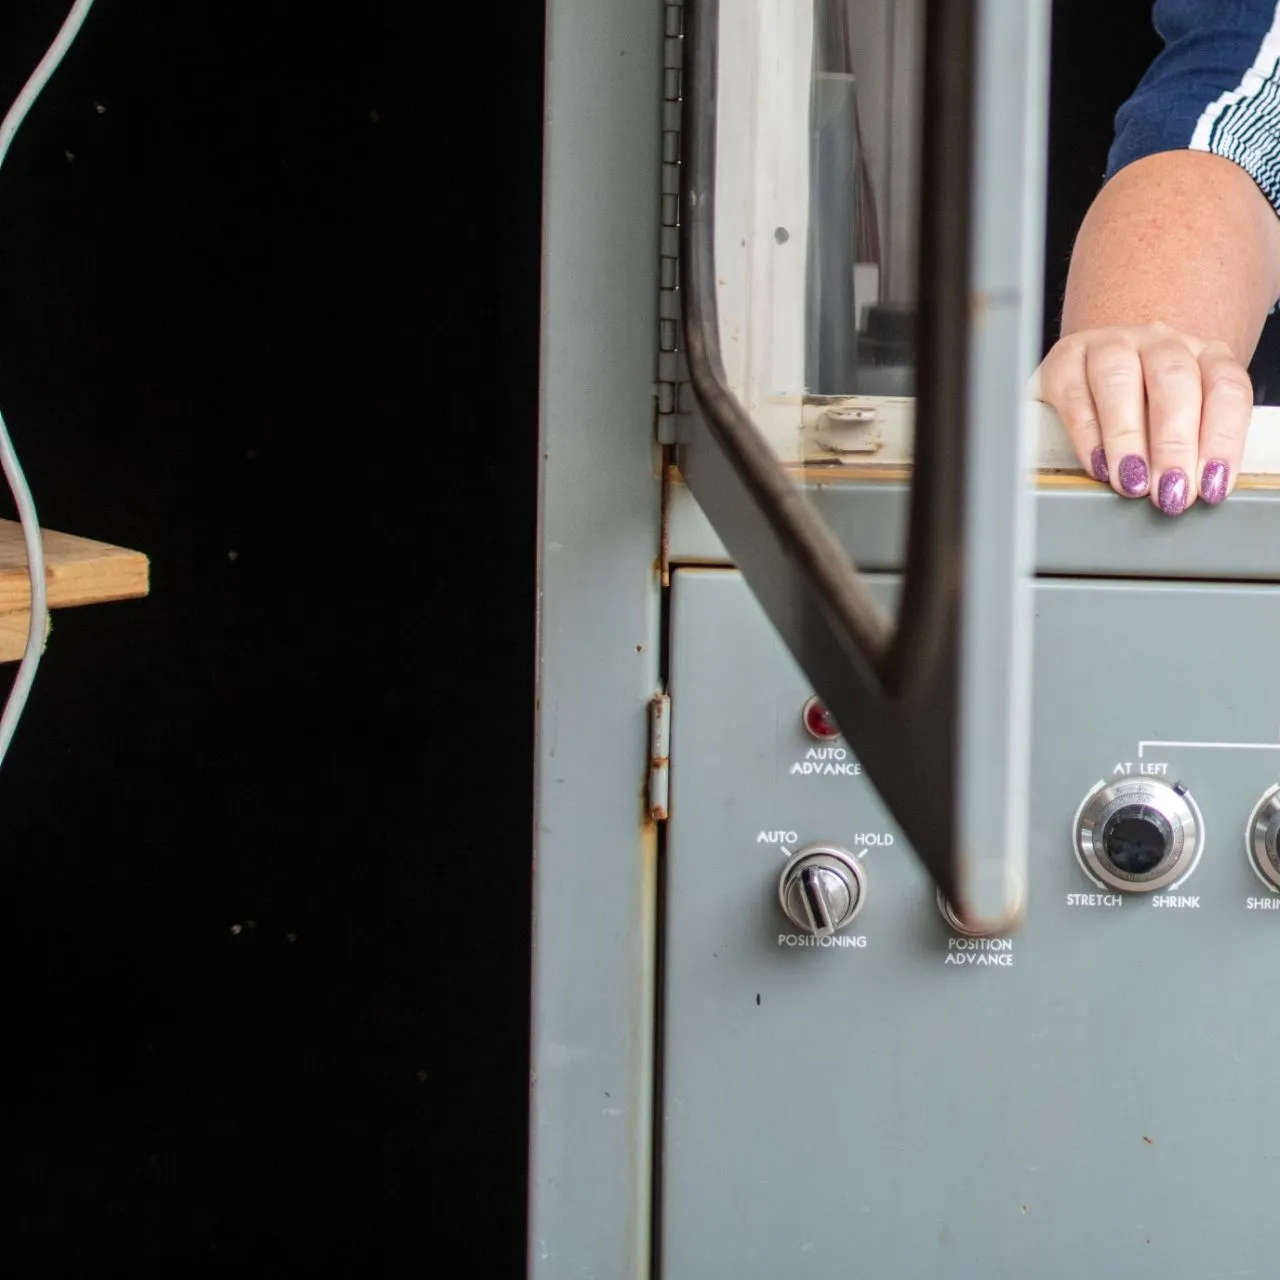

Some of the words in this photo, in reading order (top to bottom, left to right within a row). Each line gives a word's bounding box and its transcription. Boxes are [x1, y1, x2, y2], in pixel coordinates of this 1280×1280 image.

[805, 747, 847, 761] AUTO
[789, 762, 862, 776] ADVANCE
[1113, 762, 1133, 775] AT
[1140, 762, 1169, 775] LEFT
[756, 830, 798, 844] AUTO
[854, 832, 894, 847] HOLD
[1066, 893, 1122, 907] STRETCH
[1152, 895, 1201, 908] SHRINK
[777, 934, 868, 949] POSITIONING
[948, 938, 1013, 952] POSITION
[944, 953, 1014, 967] ADVANCE
